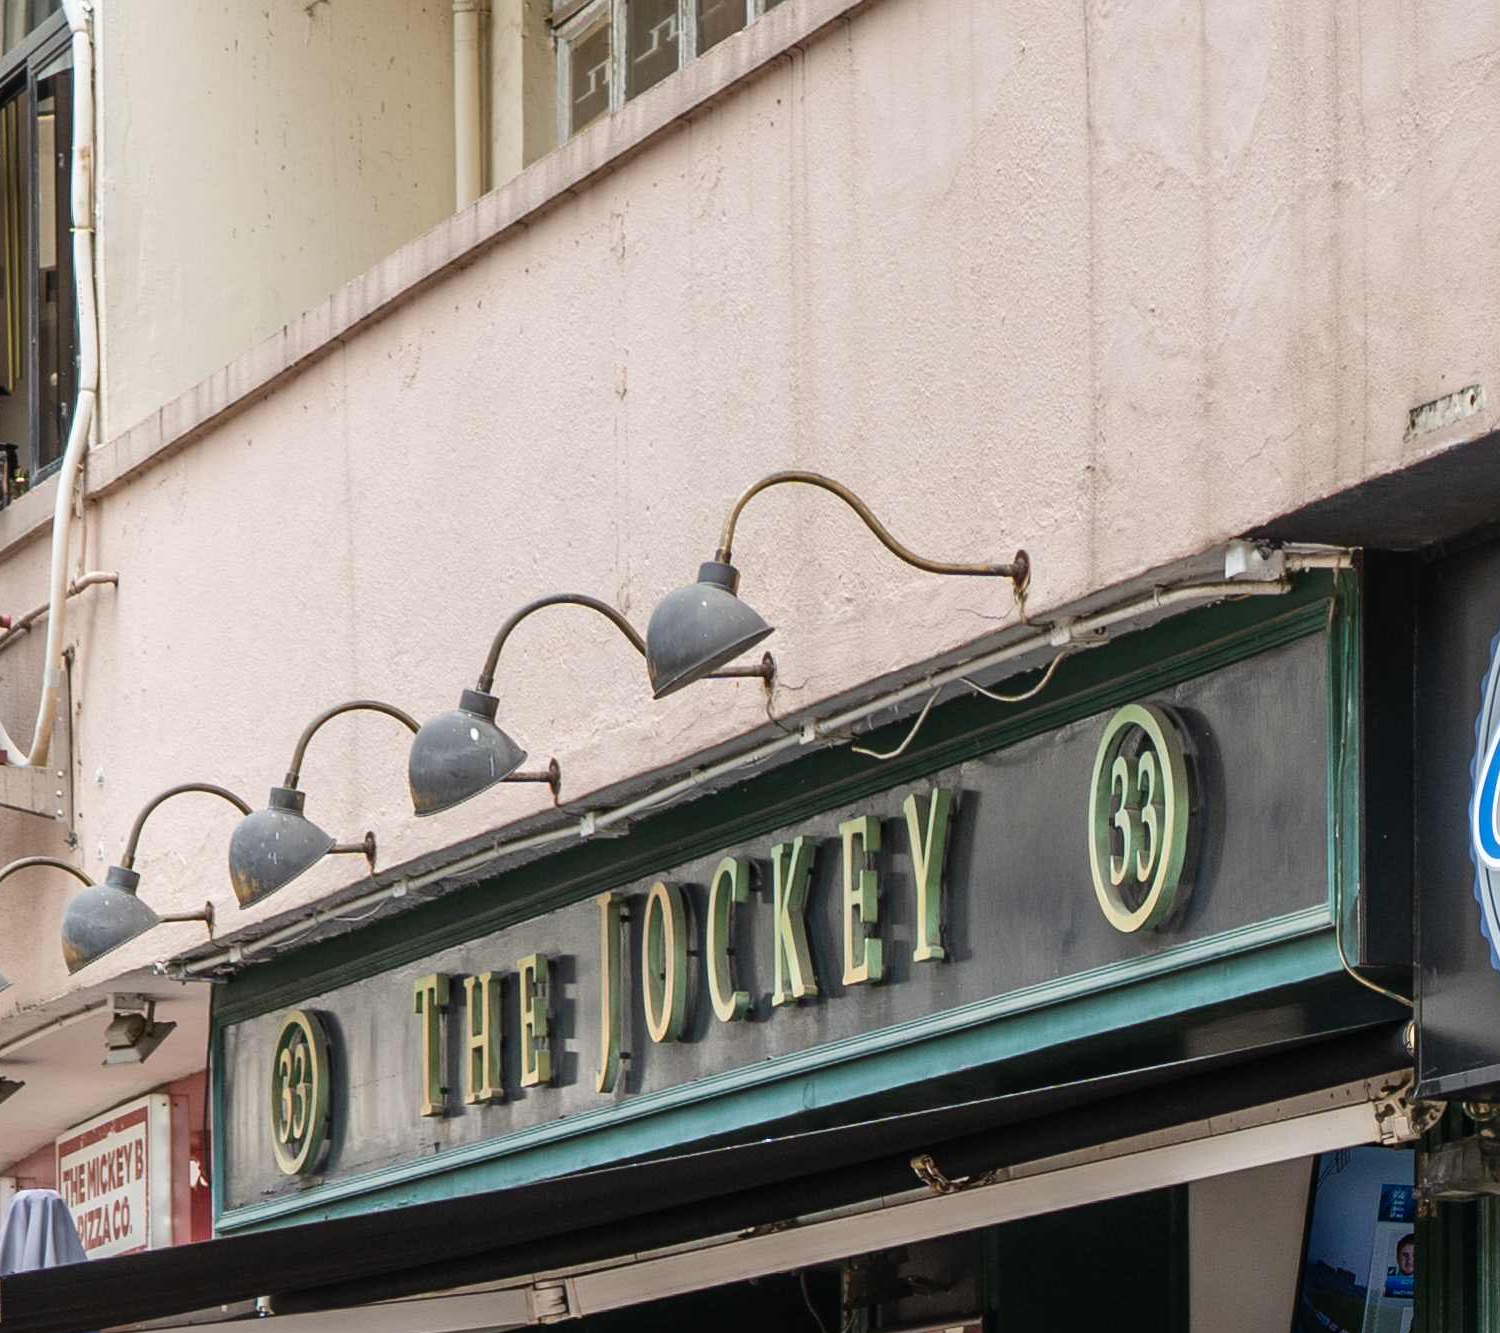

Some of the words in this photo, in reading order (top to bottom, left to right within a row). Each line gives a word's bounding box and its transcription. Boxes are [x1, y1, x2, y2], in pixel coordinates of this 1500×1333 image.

[1109, 750, 1160, 888] 33
[414, 950, 551, 1118] THE
[594, 786, 952, 1095] JOCKEY
[278, 1042, 313, 1144] 33
[63, 1162, 85, 1208] THE
[87, 1141, 132, 1200] MICKEY
[134, 1138, 144, 1181] B
